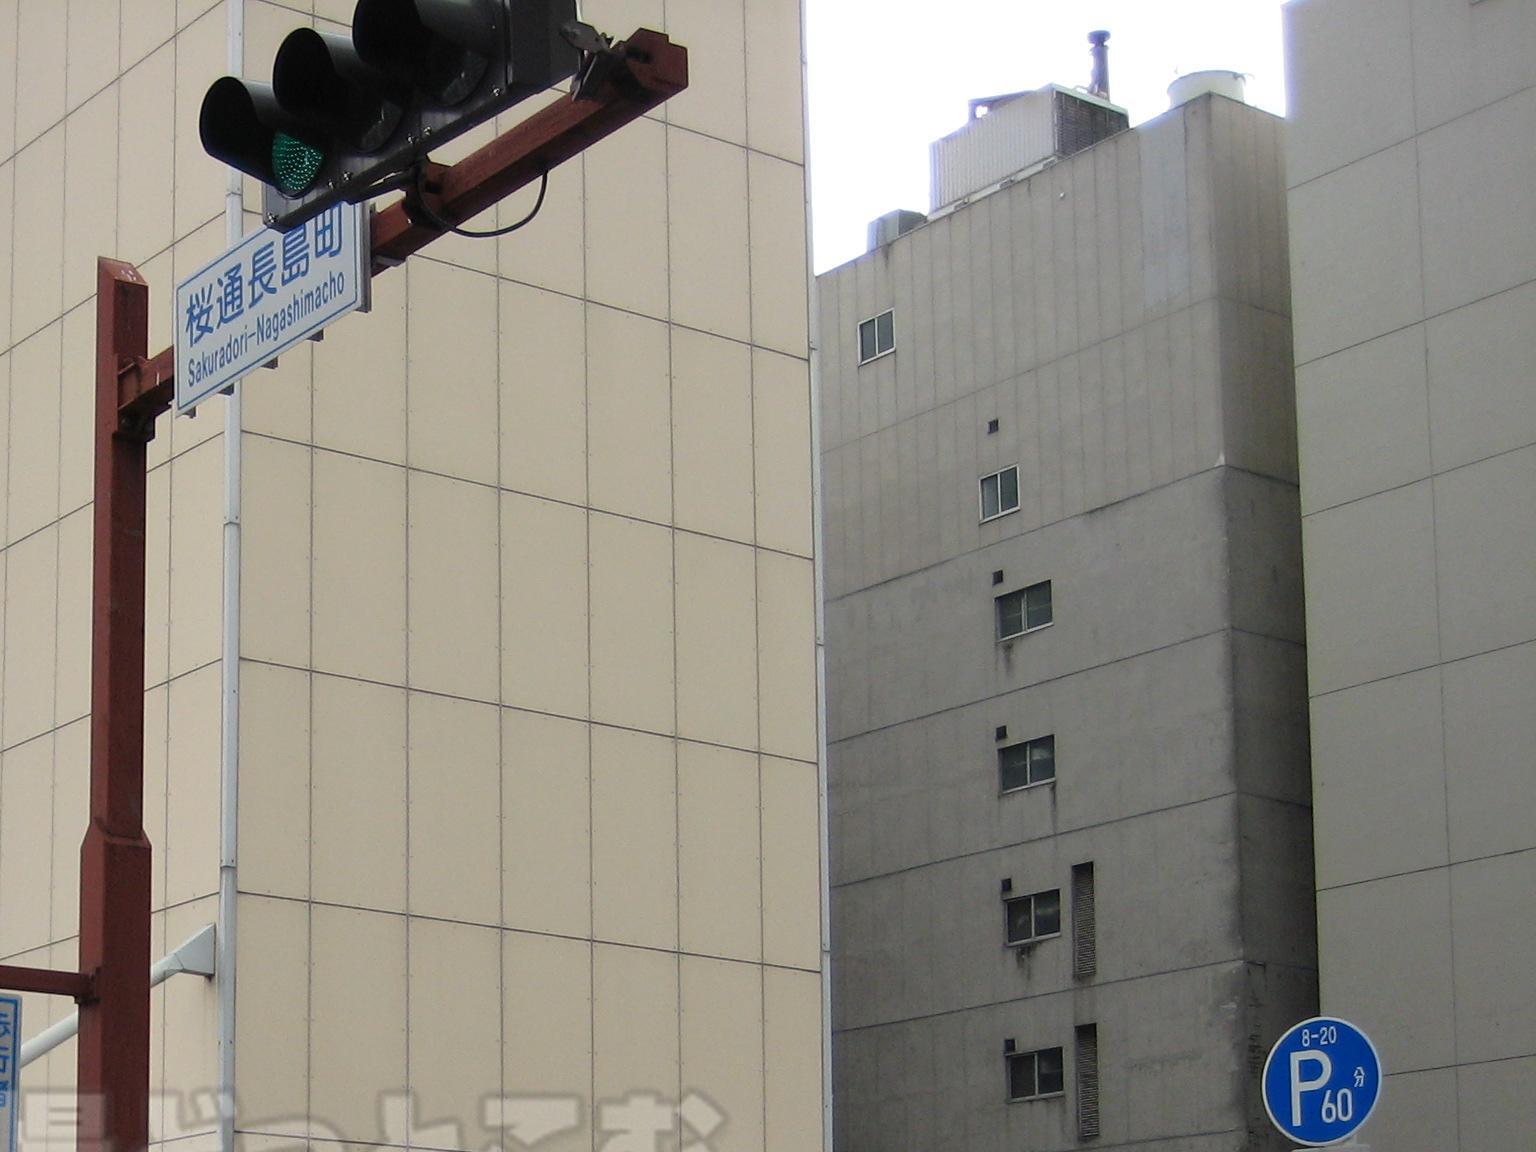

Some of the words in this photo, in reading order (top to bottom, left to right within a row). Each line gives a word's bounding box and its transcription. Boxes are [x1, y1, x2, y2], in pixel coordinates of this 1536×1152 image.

[185, 201, 343, 347] 桜通長島町
[188, 270, 345, 388] Sakuradori-Nagashimacho
[1301, 1026, 1337, 1048] 8-20
[1290, 1049, 1332, 1127] P
[1321, 1087, 1353, 1124] 60
